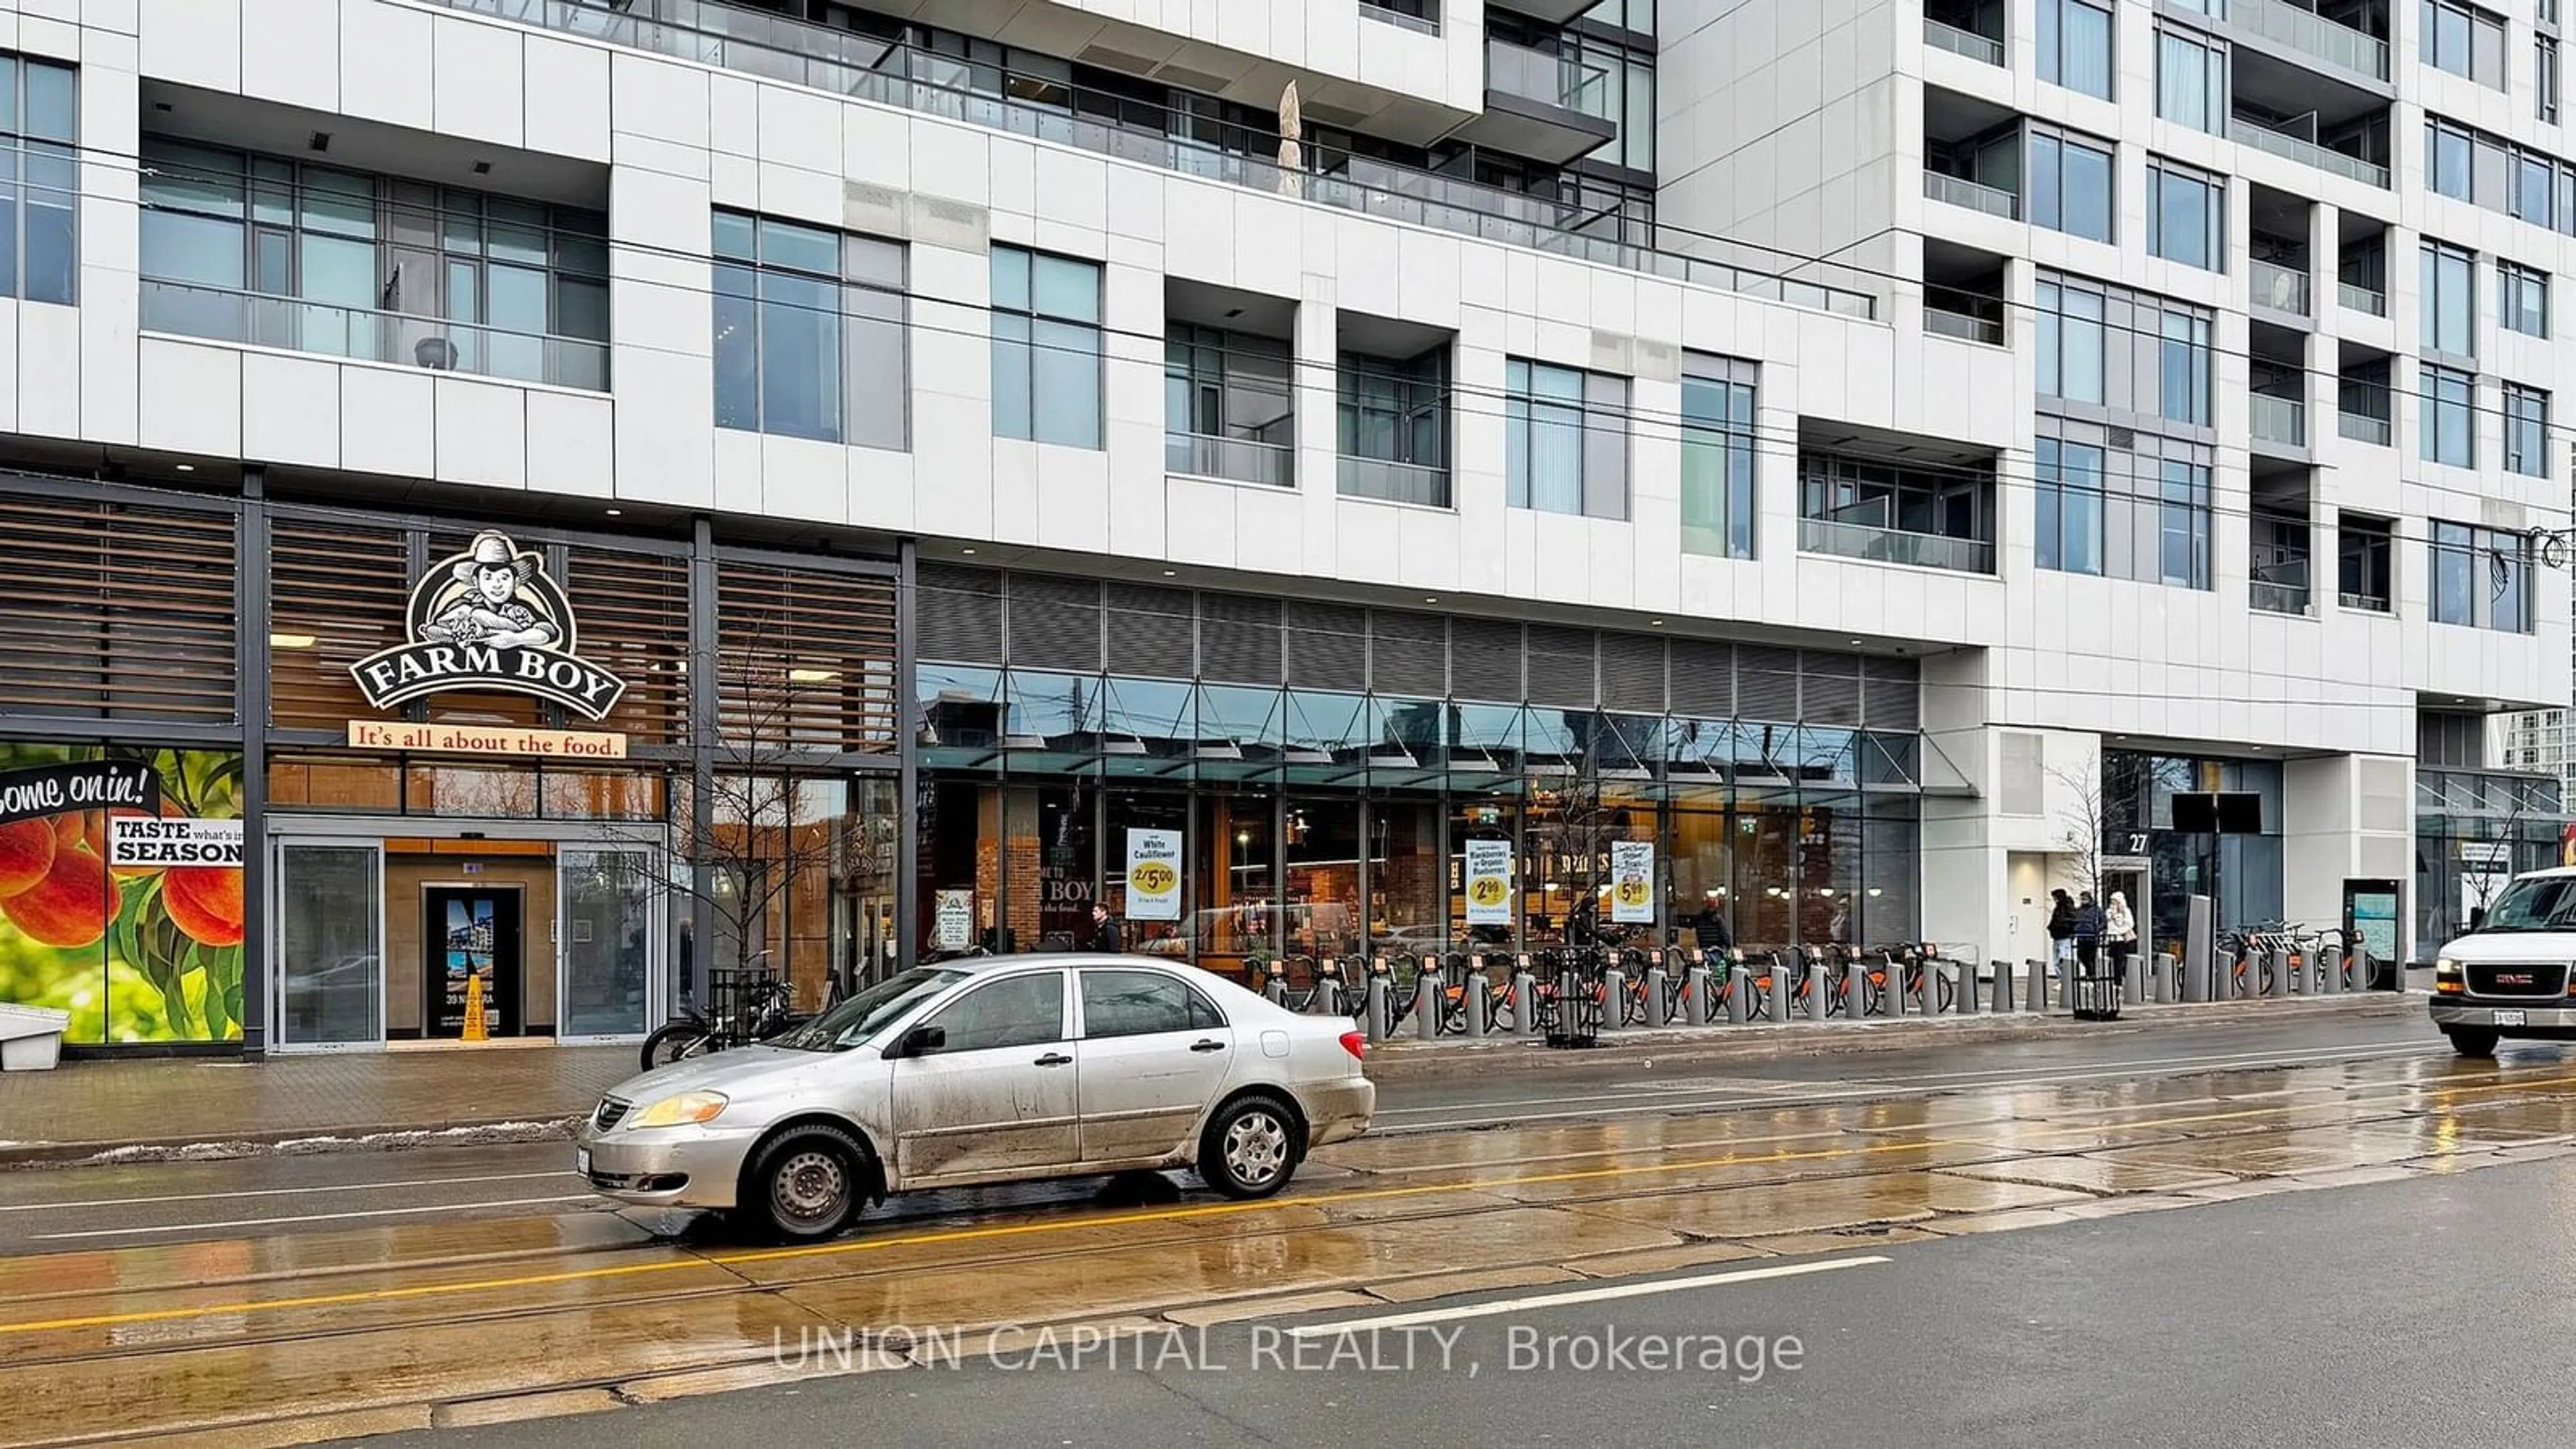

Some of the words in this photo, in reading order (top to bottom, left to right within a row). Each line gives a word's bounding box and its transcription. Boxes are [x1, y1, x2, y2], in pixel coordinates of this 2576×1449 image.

[364, 646, 503, 694] FARM
[515, 651, 613, 702] BOY
[358, 726, 392, 745] It's
[403, 729, 432, 747] all
[443, 731, 508, 750] about
[519, 735, 553, 753] the
[564, 737, 619, 756] food.
[70, 775, 106, 802] on
[107, 766, 148, 804] in!
[116, 821, 190, 839] TASTE
[193, 829, 232, 840] what's
[117, 842, 244, 862] SEASON
[2129, 834, 2148, 853] 27
[1050, 880, 1095, 901] BOY
